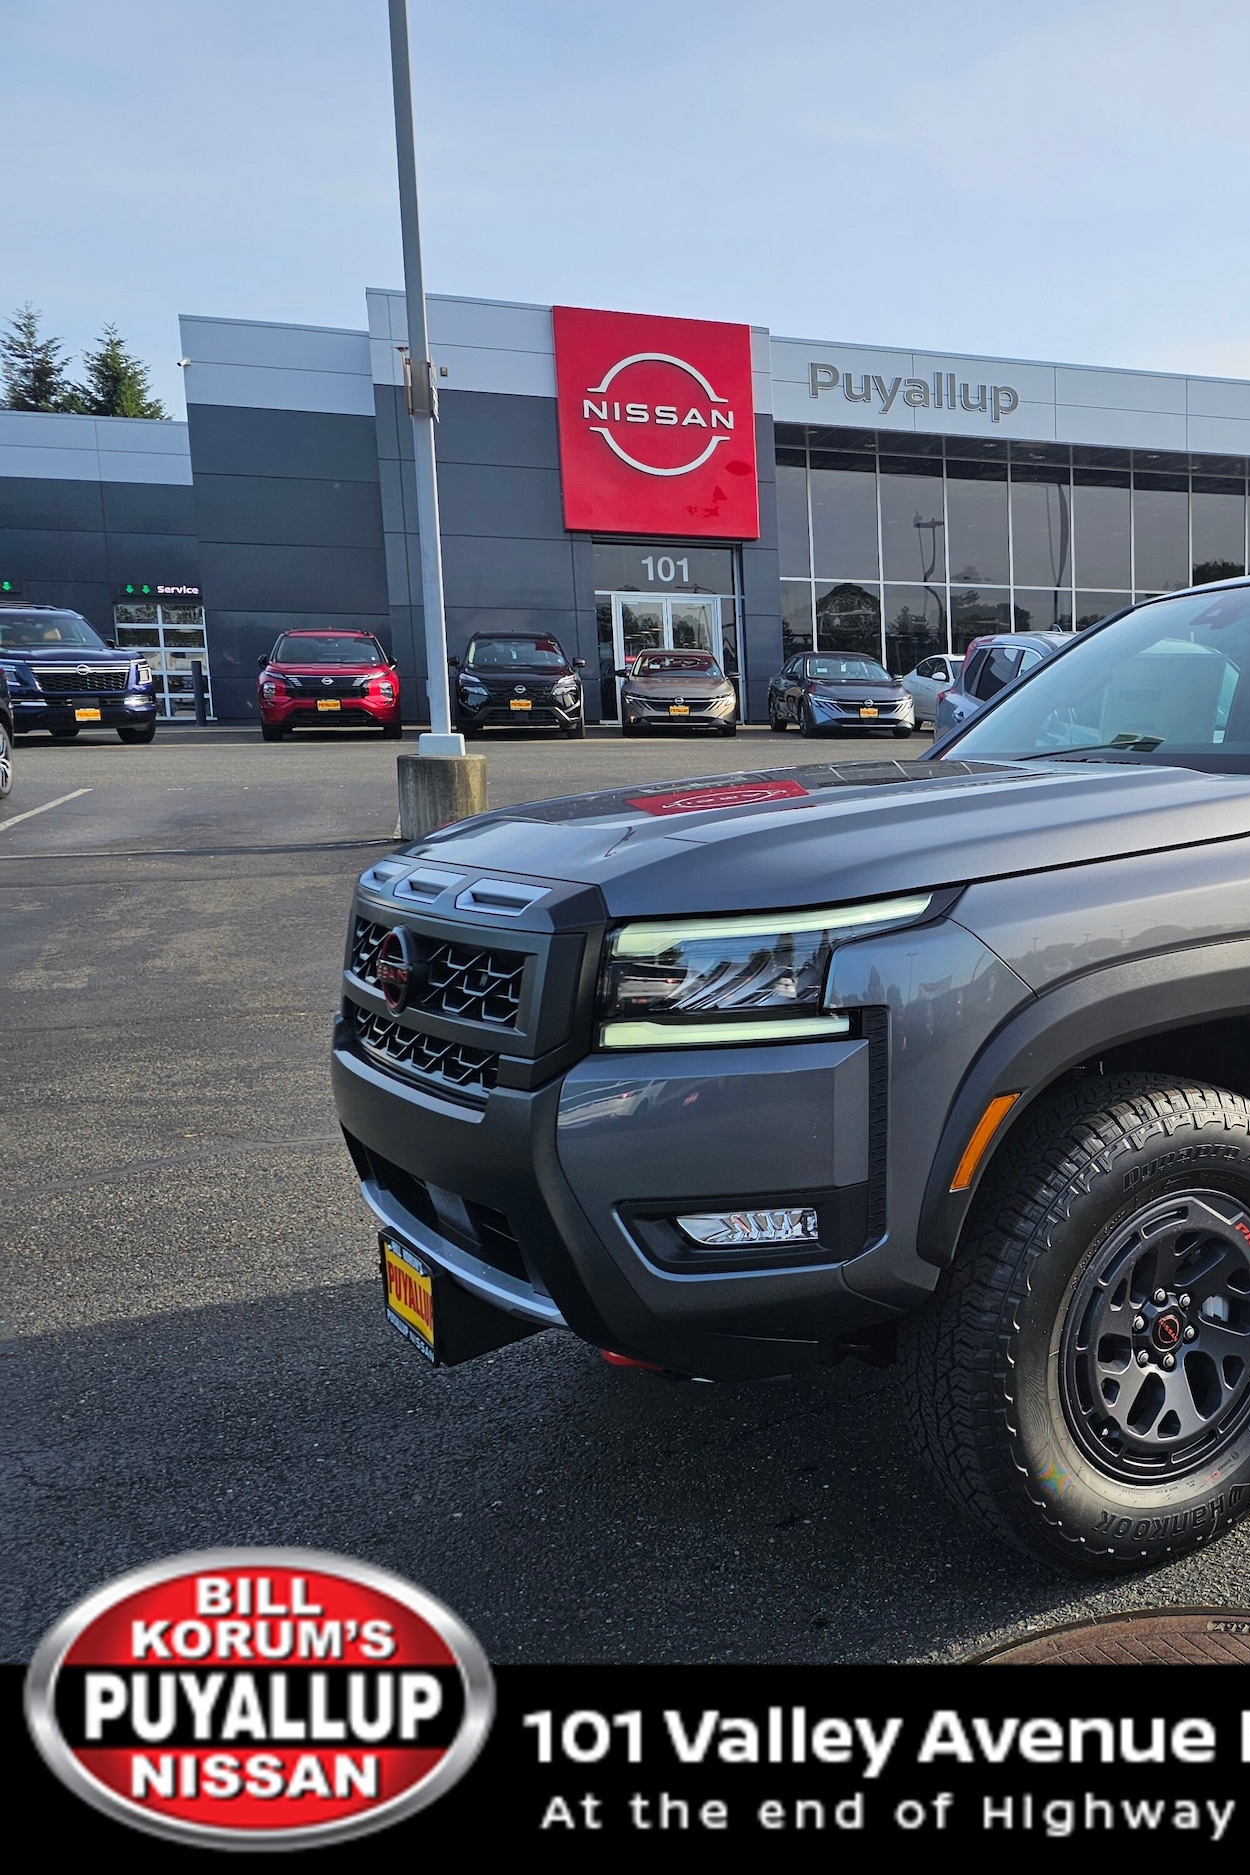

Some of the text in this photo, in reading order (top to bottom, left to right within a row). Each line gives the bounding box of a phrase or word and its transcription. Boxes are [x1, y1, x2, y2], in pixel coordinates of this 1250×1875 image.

[808, 362, 1019, 423] Puyallup
[583, 399, 735, 430] NISSAN
[641, 556, 689, 582] 101
[156, 585, 199, 595] Service
